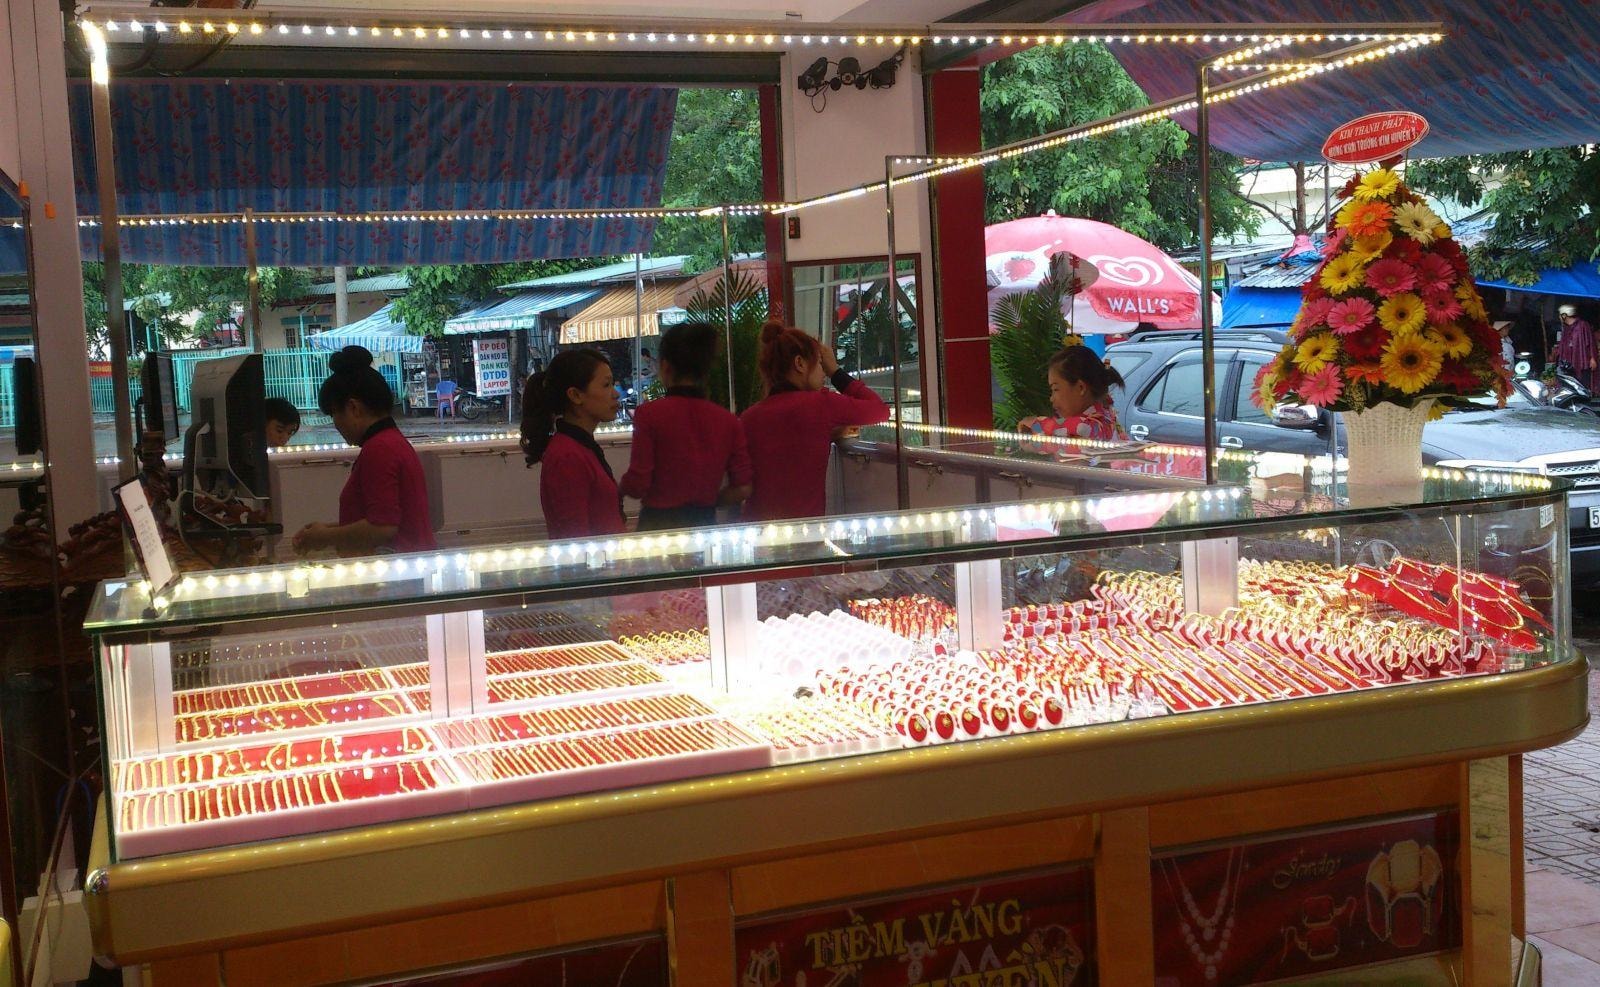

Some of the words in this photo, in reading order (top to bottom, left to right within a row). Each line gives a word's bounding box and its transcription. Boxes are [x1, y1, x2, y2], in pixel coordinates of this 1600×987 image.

[1340, 130, 1353, 140] KIM
[1354, 122, 1380, 136] THANH
[1107, 297, 1170, 314] WALL'S
[484, 381, 508, 389] LAPTOP
[918, 898, 1023, 949] VÀNG
